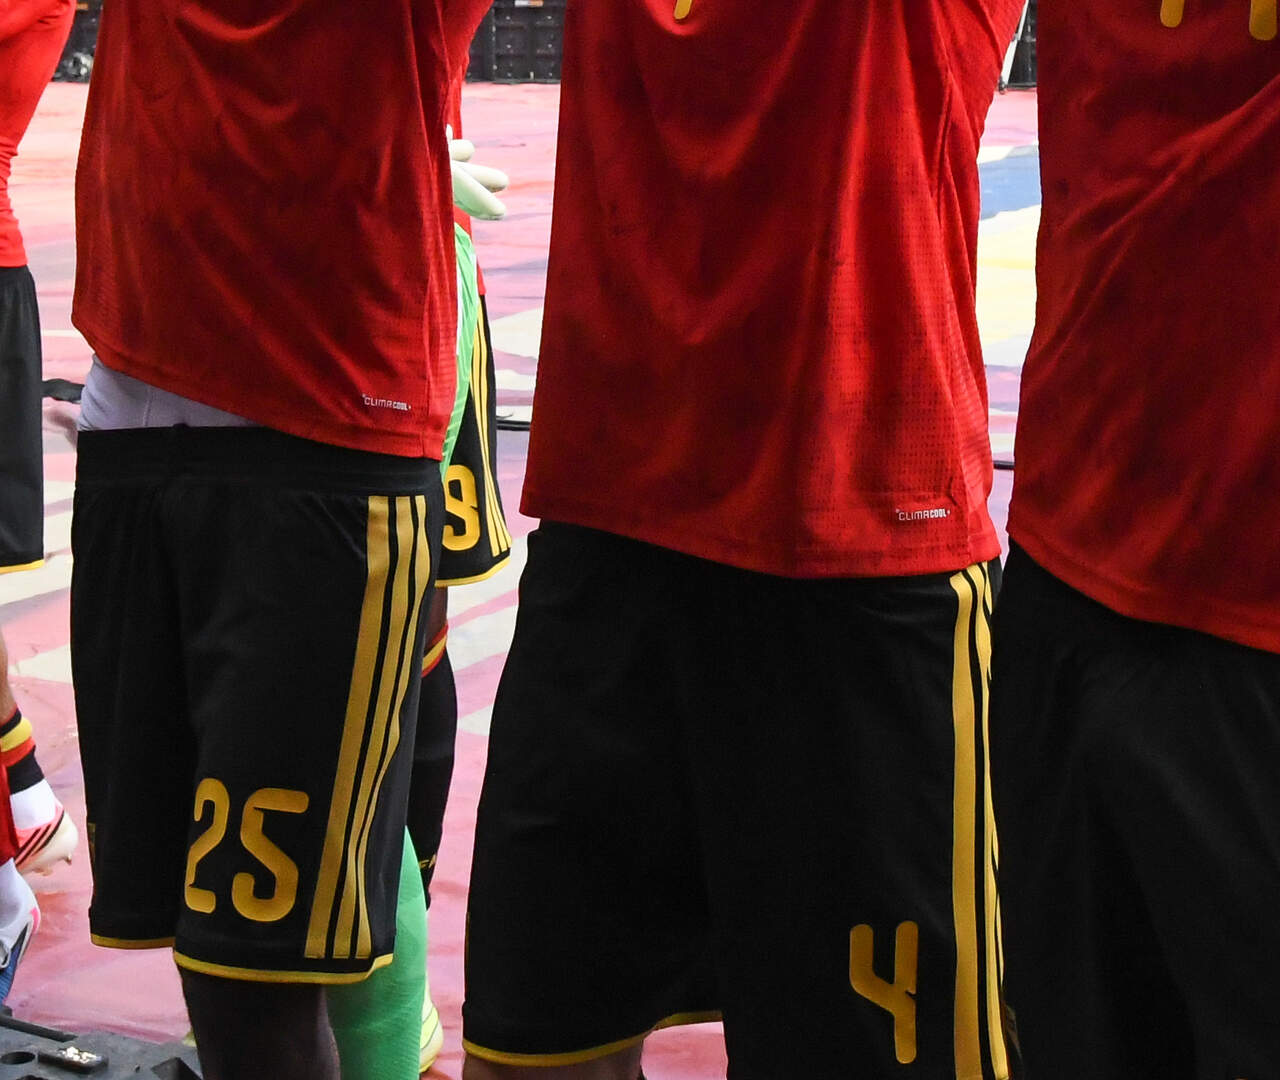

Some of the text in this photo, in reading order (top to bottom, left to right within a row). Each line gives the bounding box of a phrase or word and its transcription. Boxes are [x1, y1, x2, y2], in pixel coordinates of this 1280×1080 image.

[897, 508, 948, 521] CLIMACOOL
[185, 777, 310, 923] 25
[848, 920, 918, 1065] 4
